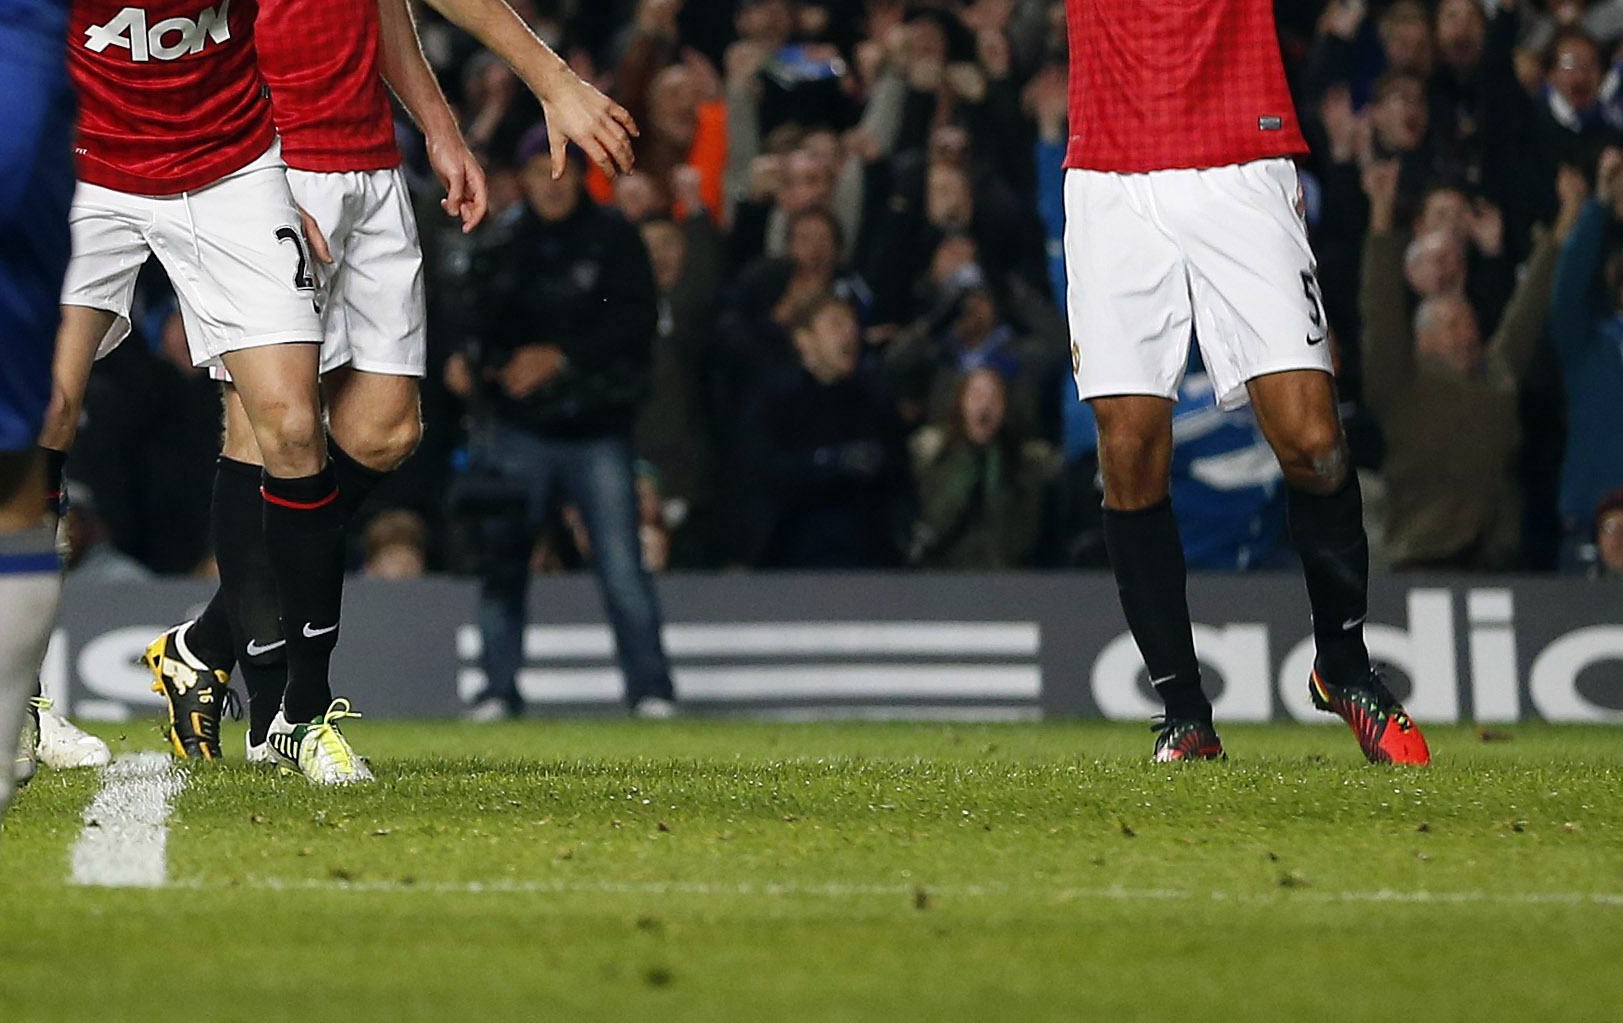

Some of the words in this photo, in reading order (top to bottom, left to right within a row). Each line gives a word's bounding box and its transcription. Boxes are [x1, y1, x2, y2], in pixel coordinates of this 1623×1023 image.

[275, 226, 322, 314] 2
[1300, 269, 1322, 328] 5
[197, 686, 214, 704] 16
